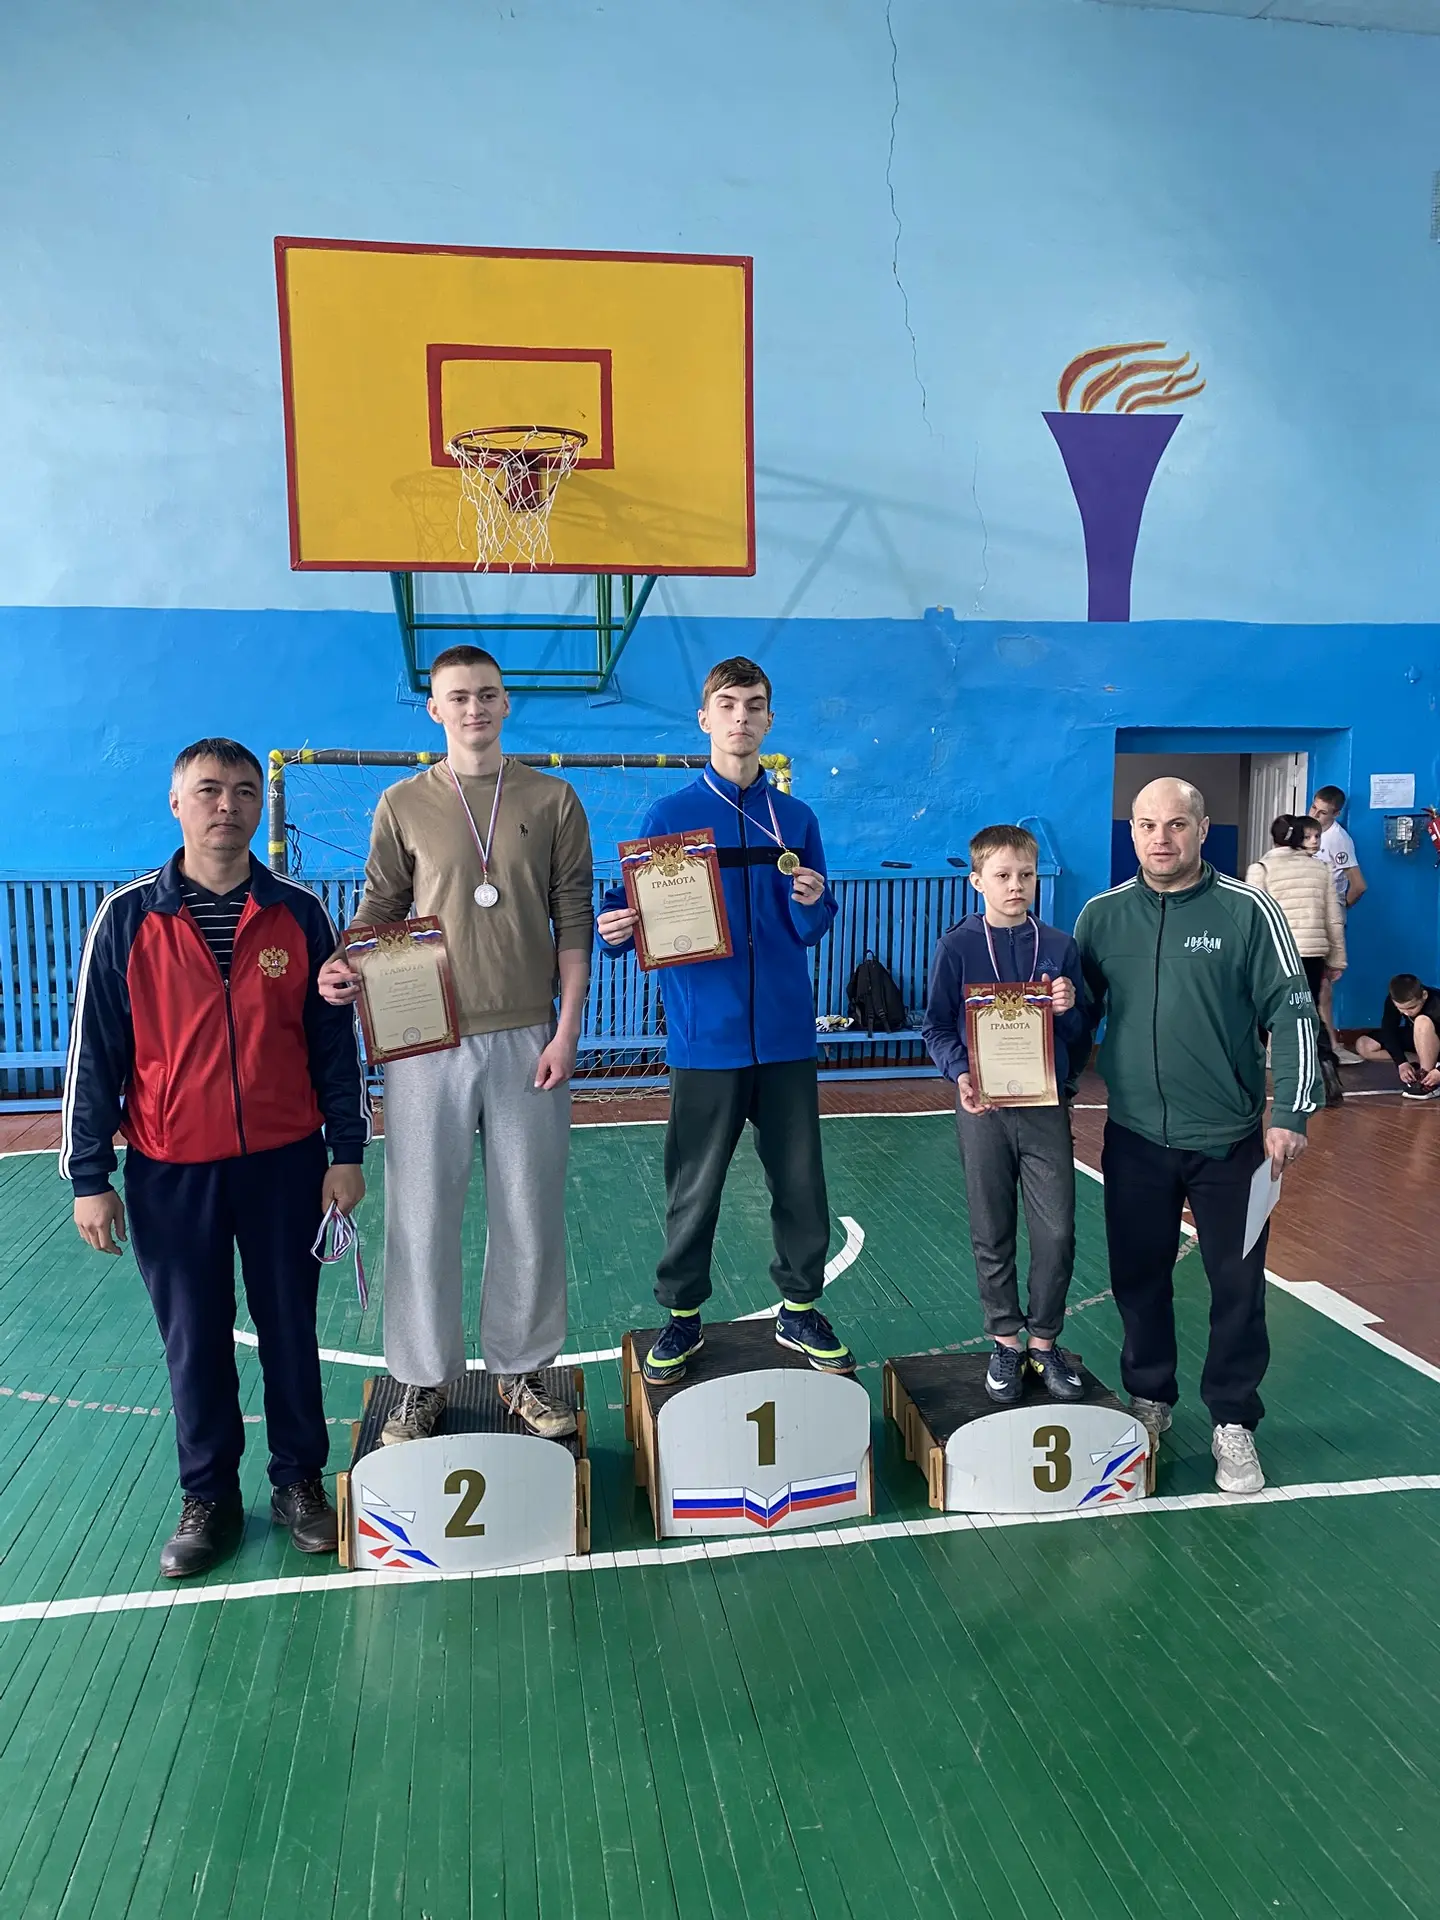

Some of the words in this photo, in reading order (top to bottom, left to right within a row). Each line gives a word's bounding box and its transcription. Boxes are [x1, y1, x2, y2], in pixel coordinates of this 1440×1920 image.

[652, 876, 696, 888] ГРАМОТА
[991, 1022, 1030, 1030] ГРАМОТА
[746, 1401, 776, 1467] 1
[1033, 1425, 1072, 1493] 3
[444, 1469, 486, 1538] 2
